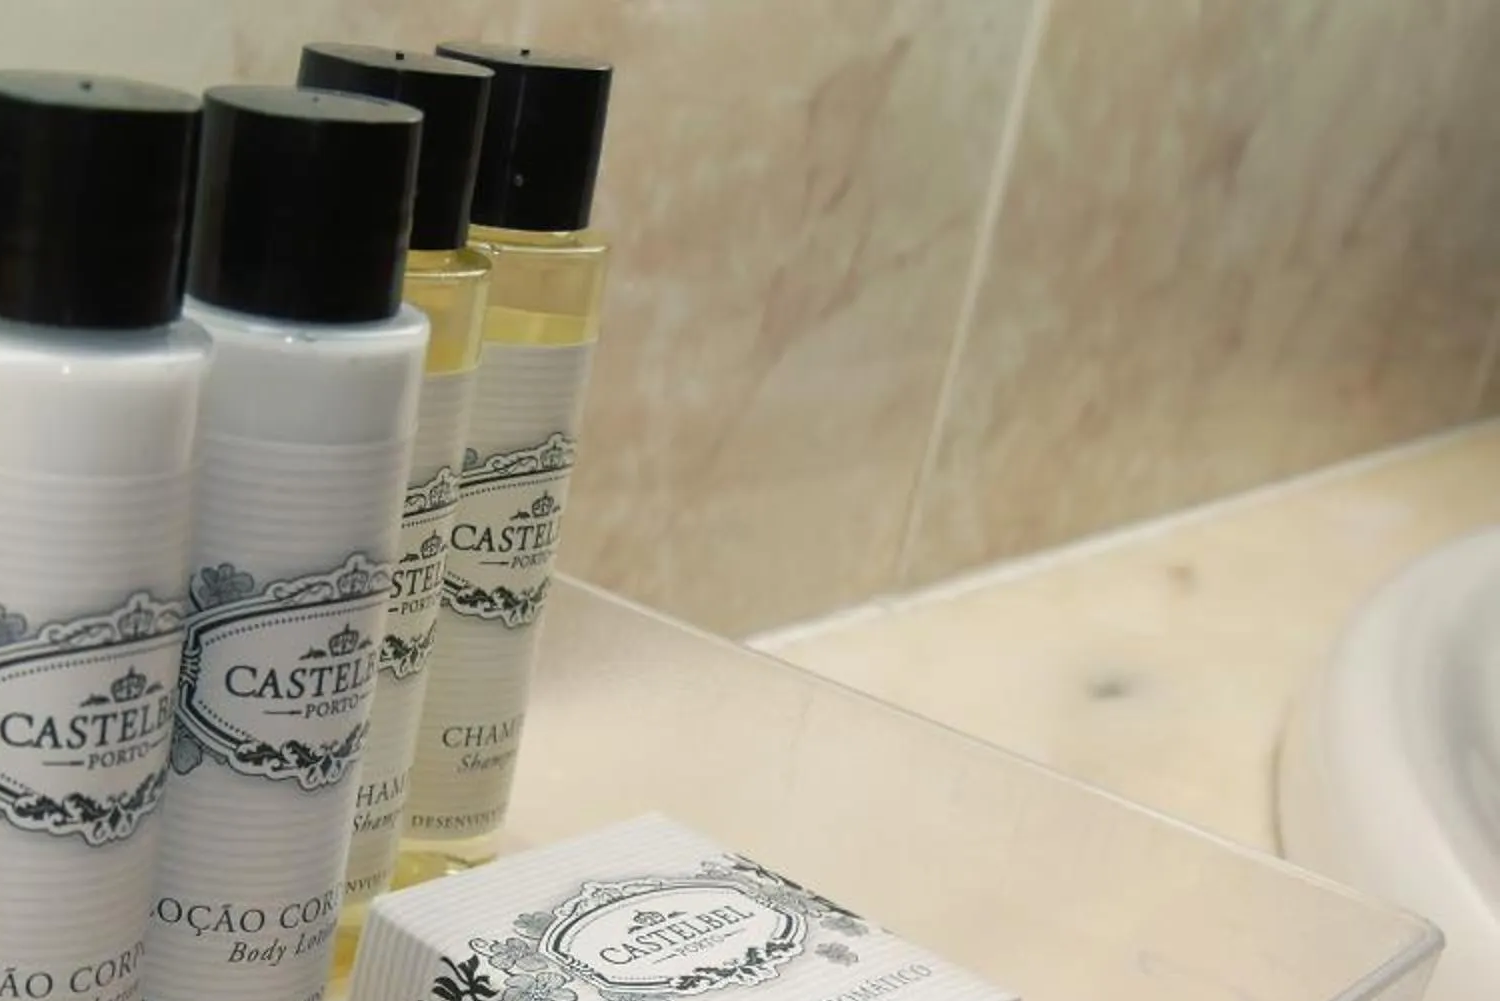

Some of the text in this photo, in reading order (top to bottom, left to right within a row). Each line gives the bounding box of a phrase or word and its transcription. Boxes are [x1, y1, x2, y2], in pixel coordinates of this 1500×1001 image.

[305, 693, 360, 719] PORTO
[87, 742, 150, 770] PORTO
[150, 897, 266, 938] OÇÃO
[599, 904, 756, 965] CASTELBEL
[227, 938, 287, 967] Body
